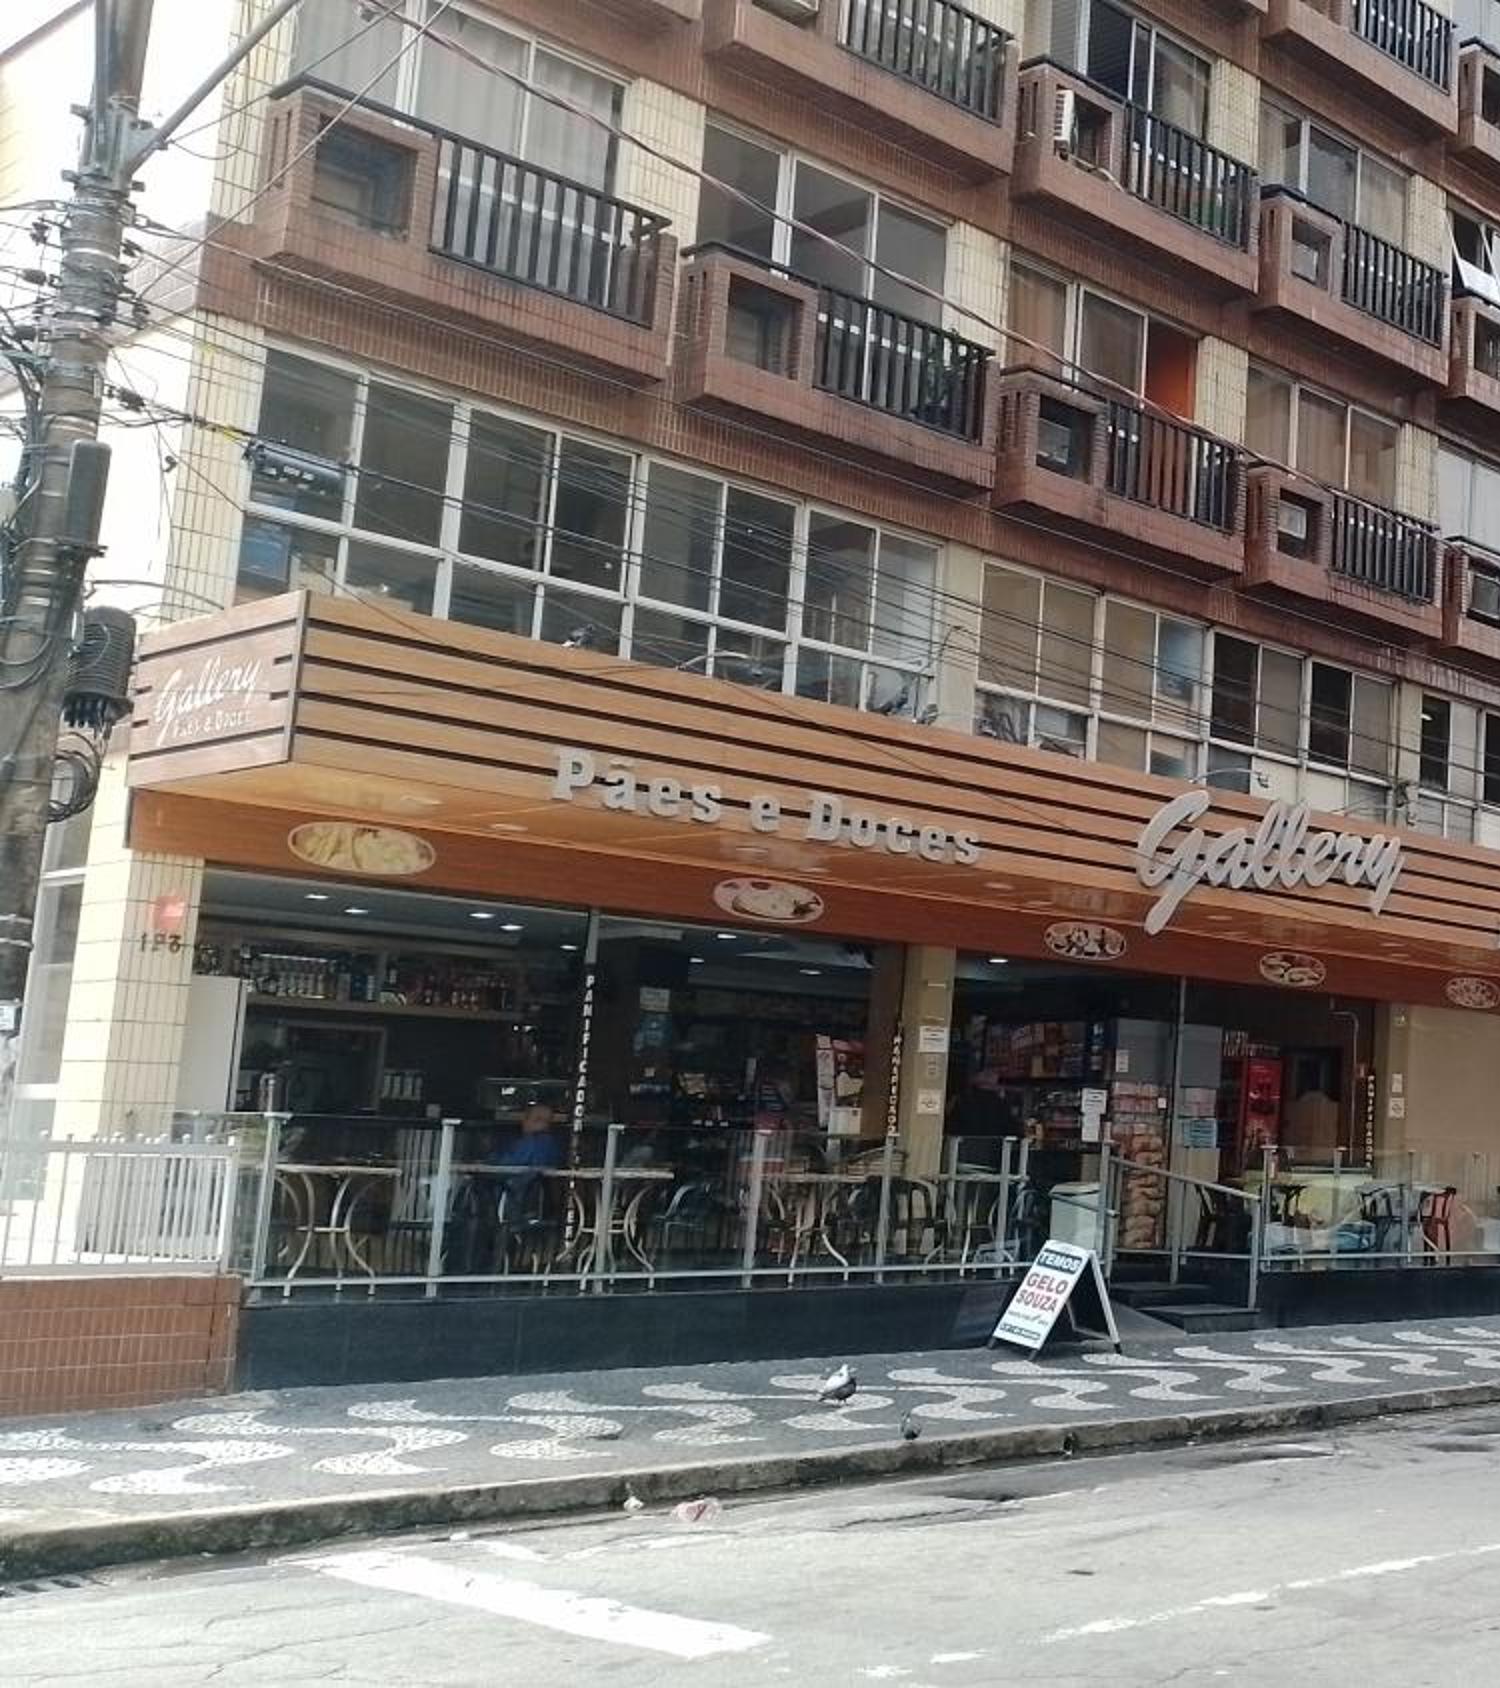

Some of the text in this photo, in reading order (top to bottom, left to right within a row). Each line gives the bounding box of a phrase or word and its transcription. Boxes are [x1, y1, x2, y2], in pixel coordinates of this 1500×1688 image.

[154, 655, 261, 747] Gallery
[551, 749, 981, 865] Pães e Doces
[1136, 789, 1406, 936] Gallery
[1027, 1272, 1068, 1294] GELO
[1039, 1252, 1081, 1272] TEMOS
[1016, 1289, 1058, 1312] SOUZA
